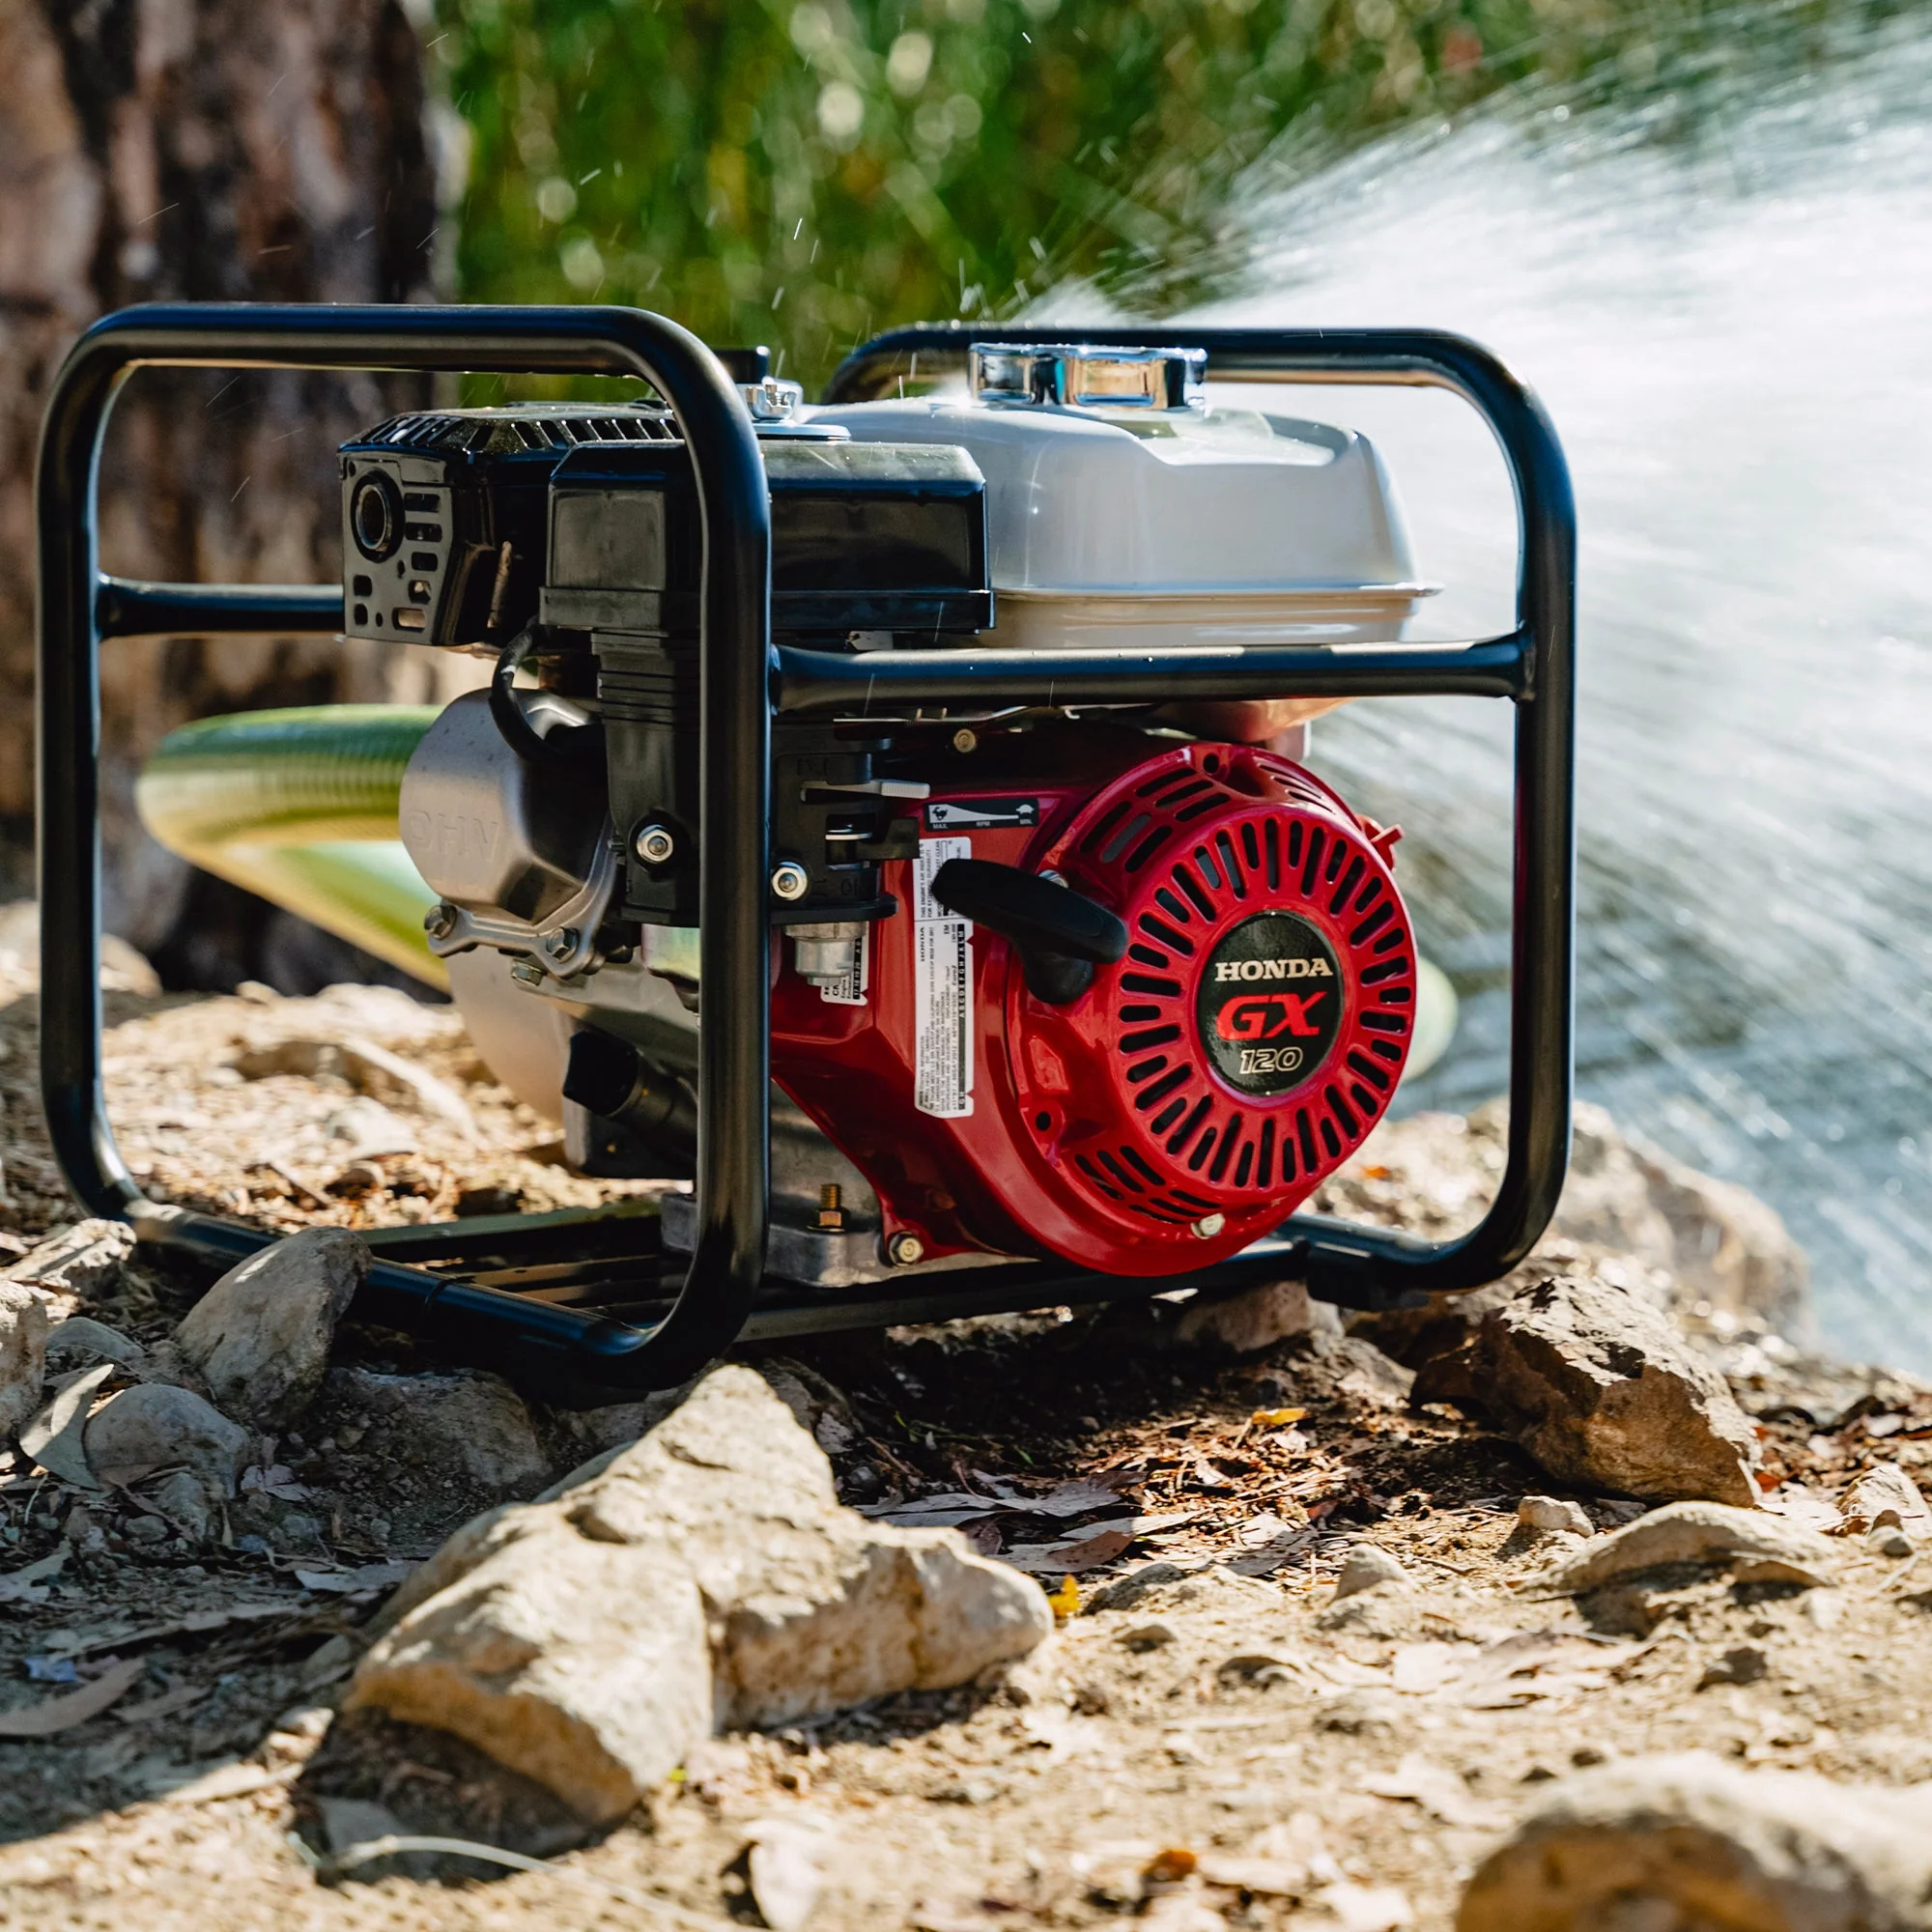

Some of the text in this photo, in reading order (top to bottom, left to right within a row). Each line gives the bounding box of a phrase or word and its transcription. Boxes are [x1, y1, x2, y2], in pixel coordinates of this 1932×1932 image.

[944, 925, 950, 935] EM
[1214, 958, 1333, 981] HONDA
[1215, 991, 1328, 1040] GX
[1239, 1047, 1303, 1074] 120
